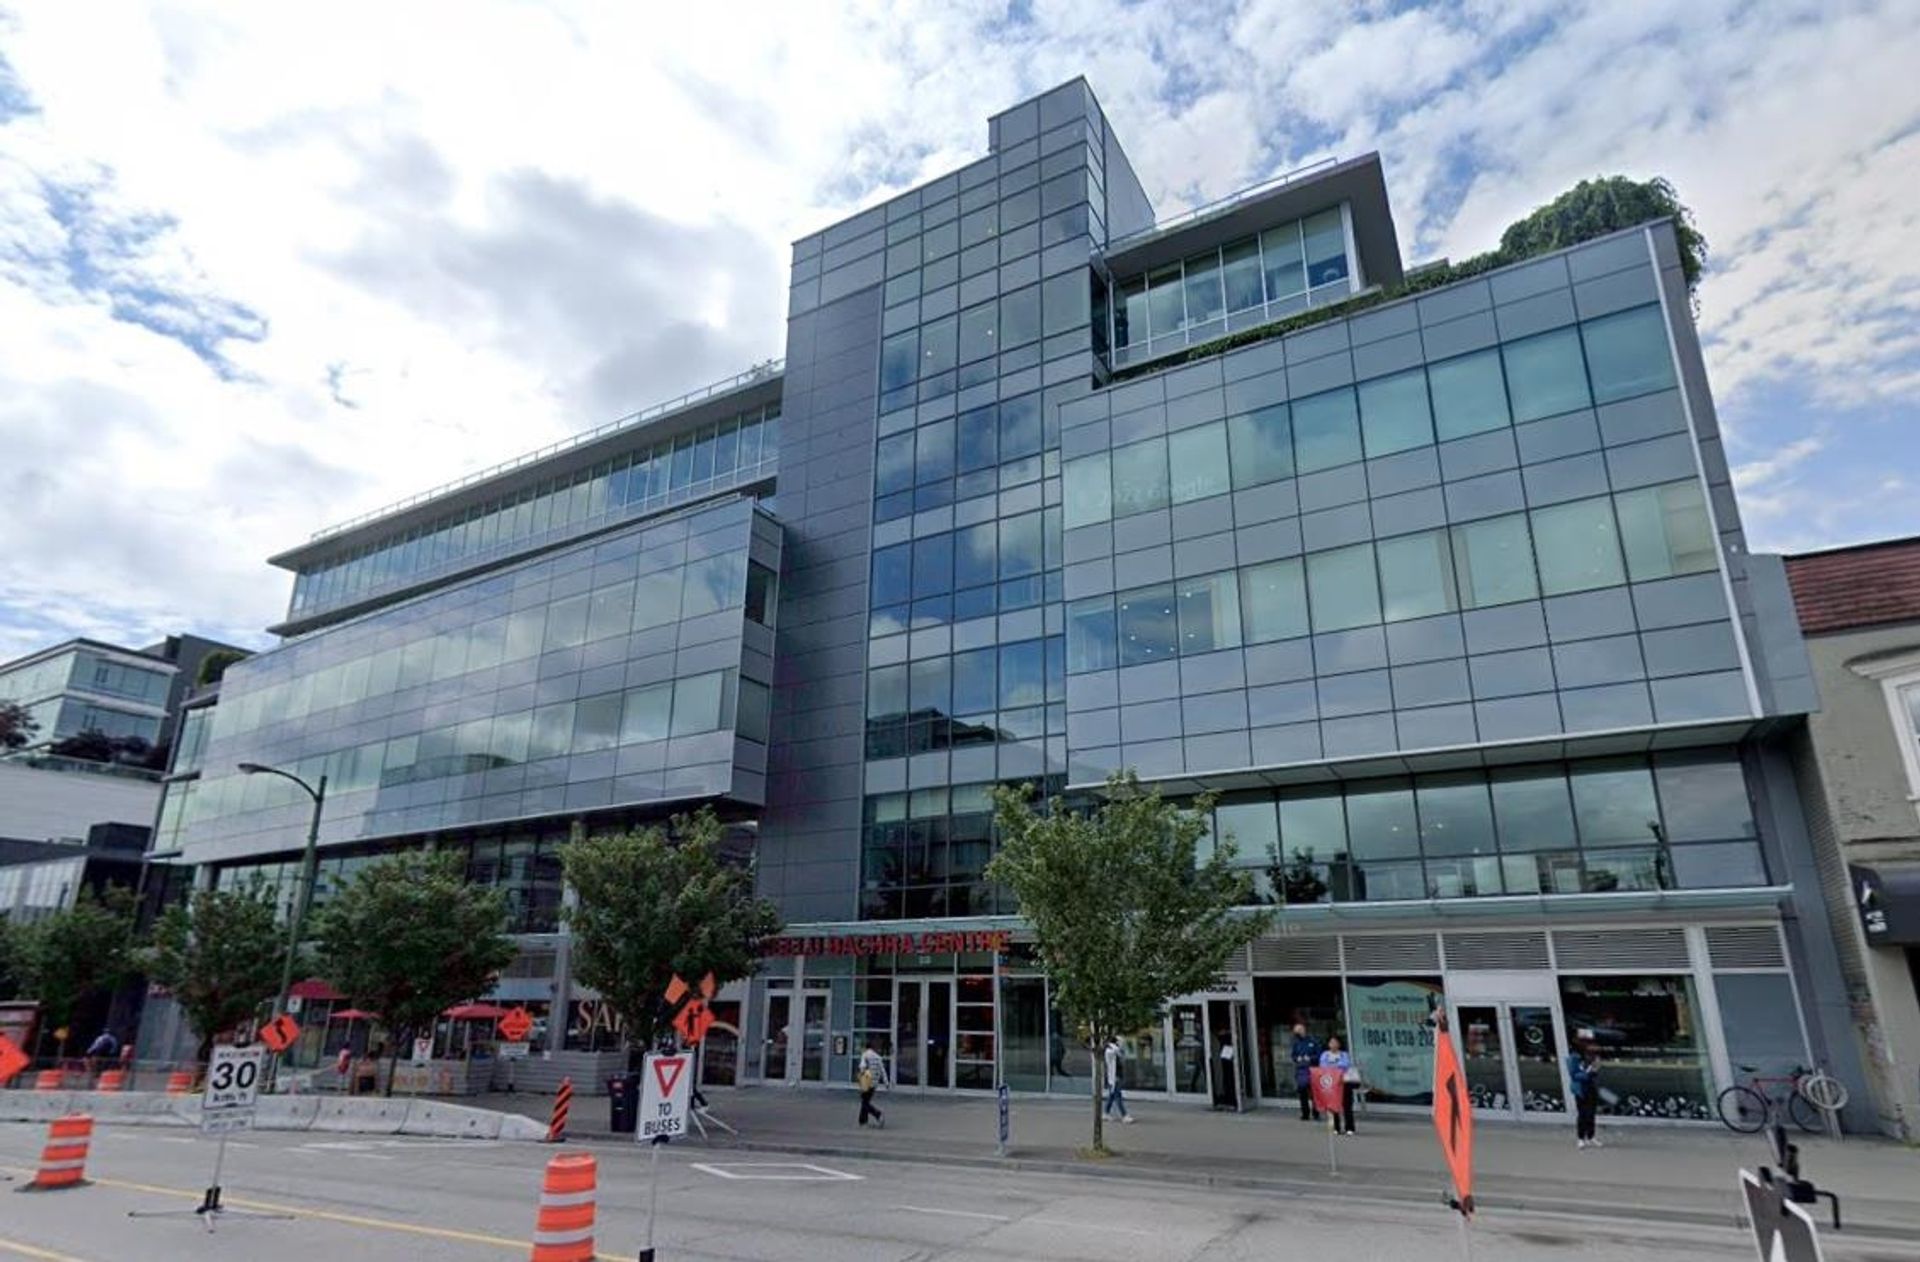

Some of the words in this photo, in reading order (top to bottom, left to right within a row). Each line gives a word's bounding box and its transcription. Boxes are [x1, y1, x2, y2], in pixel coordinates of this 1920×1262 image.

[918, 928, 1010, 953] CENTRE
[211, 1060, 257, 1090] 30
[657, 1102, 673, 1117] TO
[644, 1118, 681, 1135] BUSES
